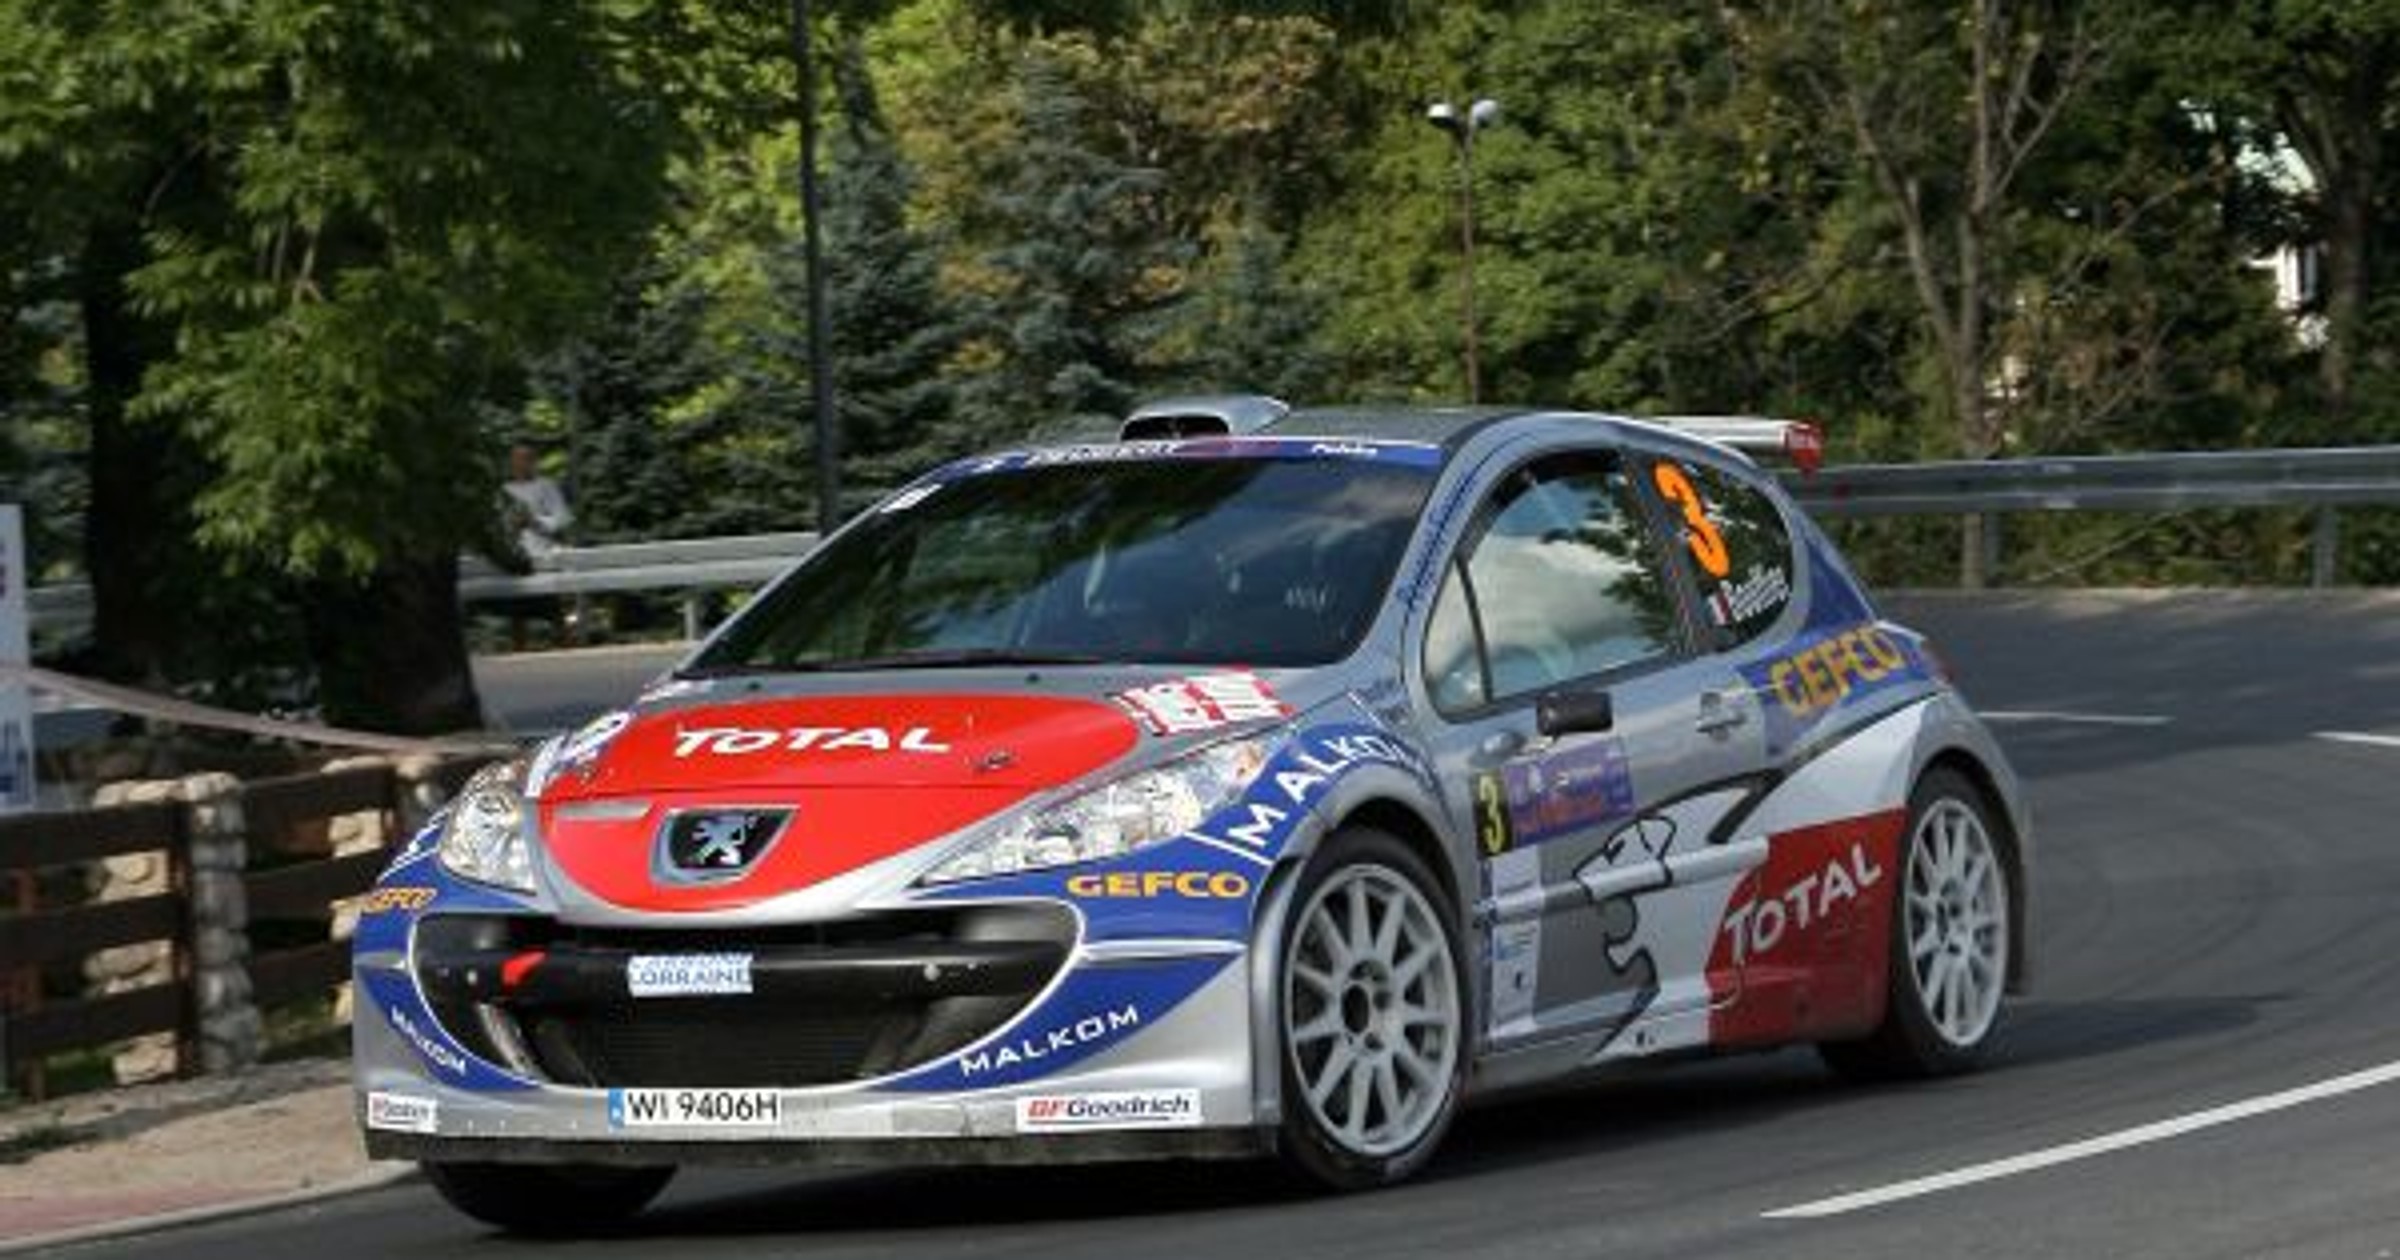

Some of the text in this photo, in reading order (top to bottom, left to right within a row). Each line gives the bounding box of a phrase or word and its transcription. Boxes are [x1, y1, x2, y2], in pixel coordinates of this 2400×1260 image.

[1654, 461, 1730, 578] 3
[1771, 627, 1904, 718] GEFCO
[674, 727, 951, 757] TOTAL
[1479, 774, 1505, 855] 3
[1067, 871, 1249, 898] GEFCO
[1724, 841, 1882, 966] TOTAL
[960, 1004, 1139, 1077] MALKOM
[628, 1092, 778, 1121] WI 9406H
[1027, 1094, 1190, 1118] BFGoodrich
